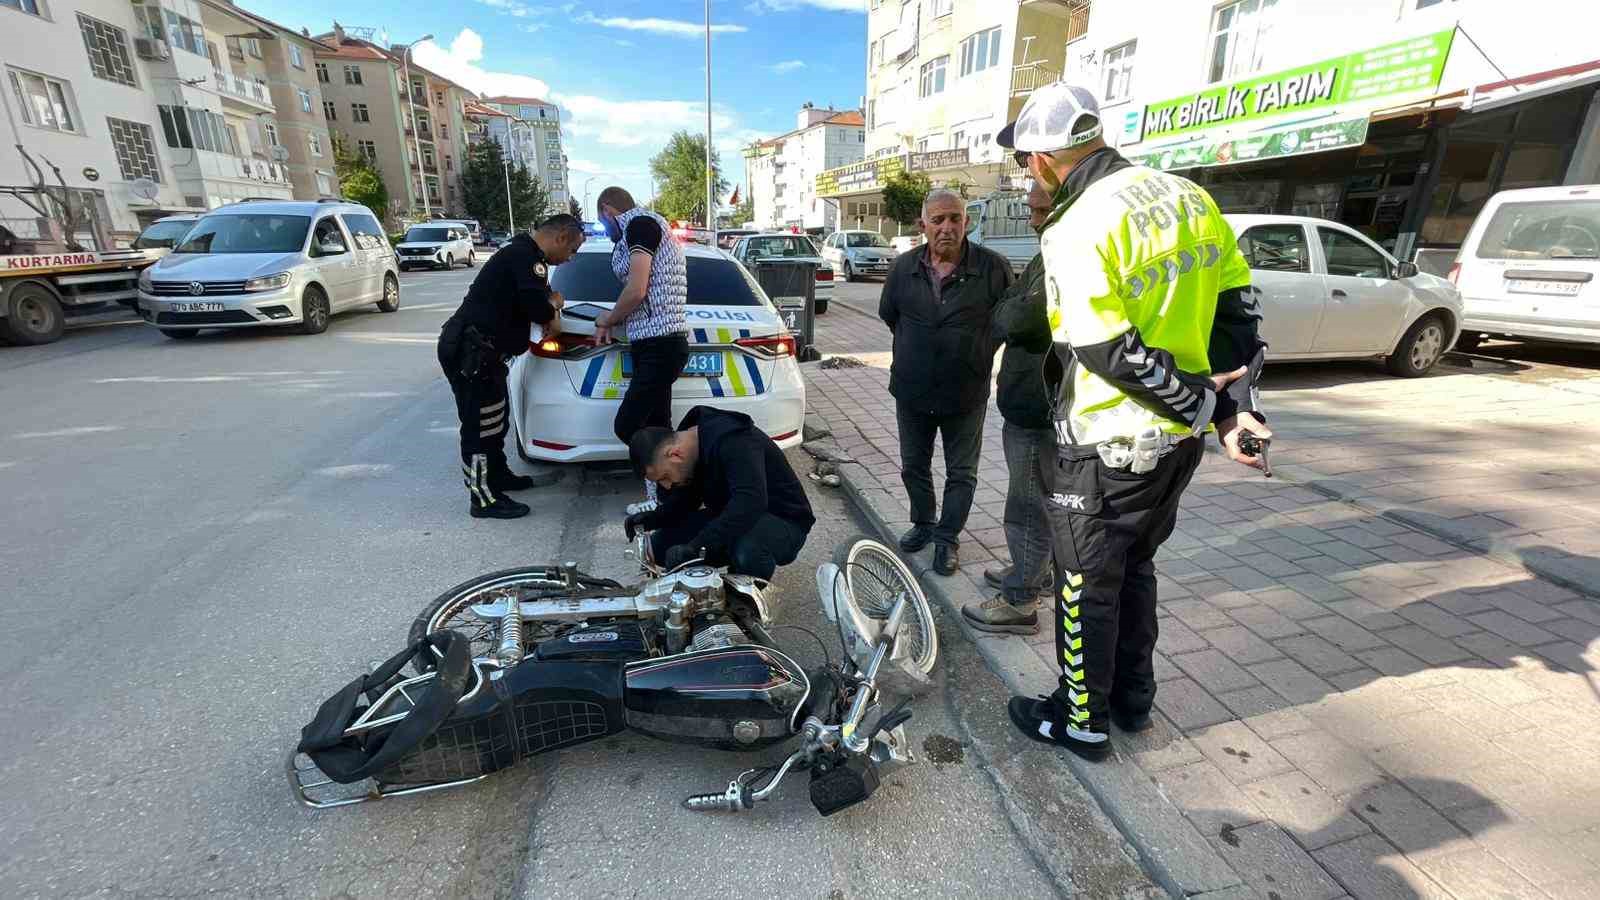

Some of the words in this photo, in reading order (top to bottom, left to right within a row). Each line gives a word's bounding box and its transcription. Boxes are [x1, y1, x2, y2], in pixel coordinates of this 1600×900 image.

[1144, 106, 1177, 136] MK
[1178, 86, 1251, 129] BİRLİK
[1254, 67, 1339, 113] TARIM
[7, 254, 96, 269] KURTARMA
[684, 355, 716, 371] 431
